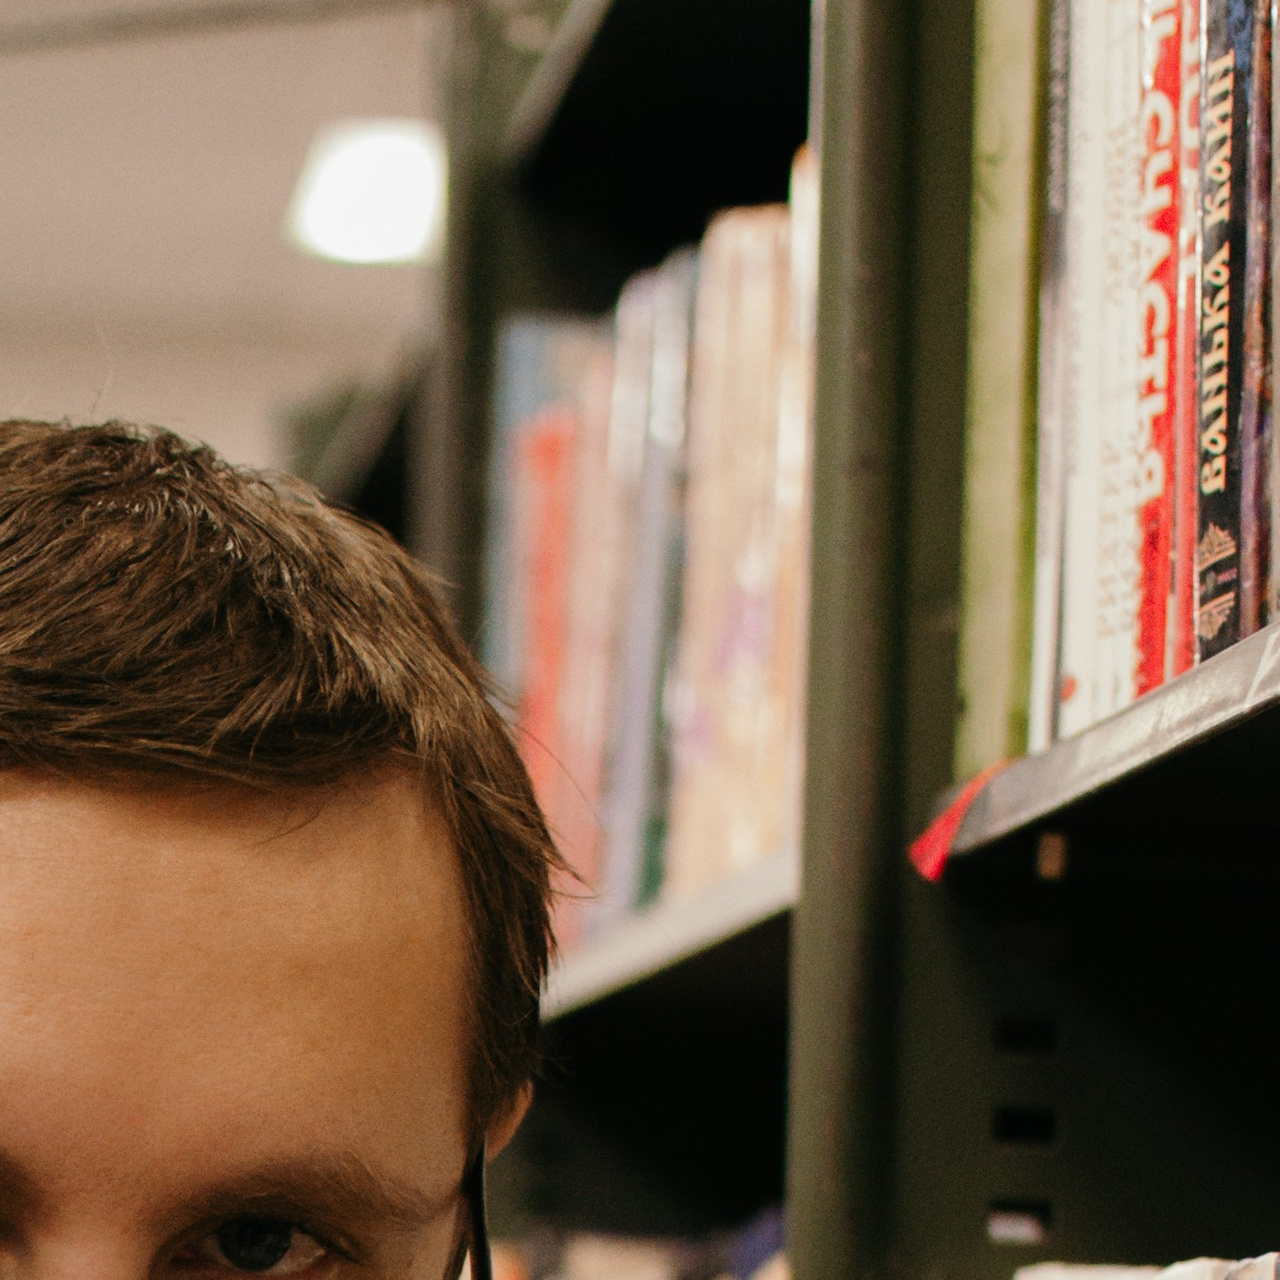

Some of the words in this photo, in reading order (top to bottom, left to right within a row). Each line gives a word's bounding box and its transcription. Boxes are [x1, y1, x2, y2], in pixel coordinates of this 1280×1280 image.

[1204, 50, 1233, 224] КАИН
[1139, 91, 1174, 501] СЧАСТЬЯ
[1200, 240, 1229, 494] ВАНЬКА
